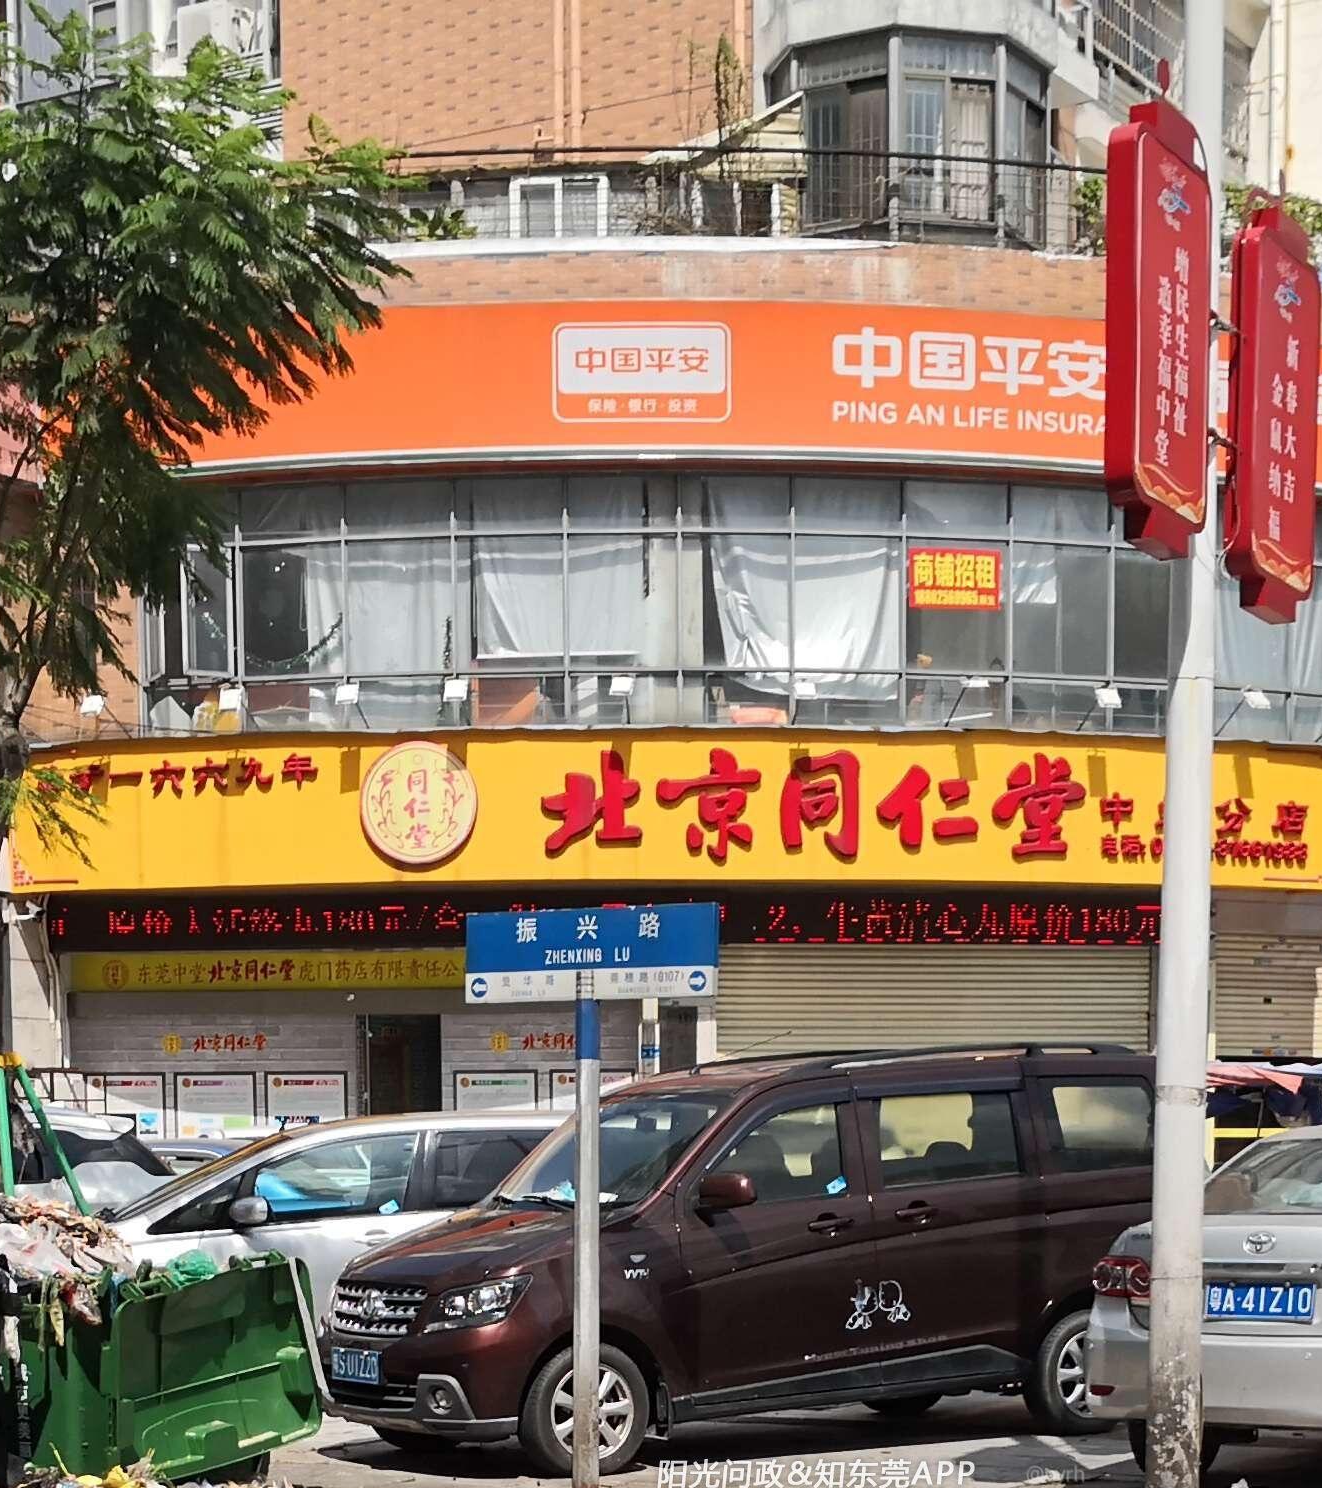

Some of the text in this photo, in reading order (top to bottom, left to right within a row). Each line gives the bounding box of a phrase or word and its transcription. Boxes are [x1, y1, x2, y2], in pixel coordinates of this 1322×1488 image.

[575, 346, 709, 374] 中国平安
[832, 401, 898, 424] PING
[906, 404, 945, 427] AN
[954, 407, 1008, 430] LIFE
[913, 553, 996, 589] 商铺招租
[404, 769, 430, 849] 同仁堂
[542, 747, 1086, 860] 北京同仁堂
[1100, 792, 1309, 840] 中分店
[516, 912, 660, 943] 振兴路
[545, 946, 630, 965] ZHENXING LU
[193, 1033, 267, 1052] 北京同仁堂
